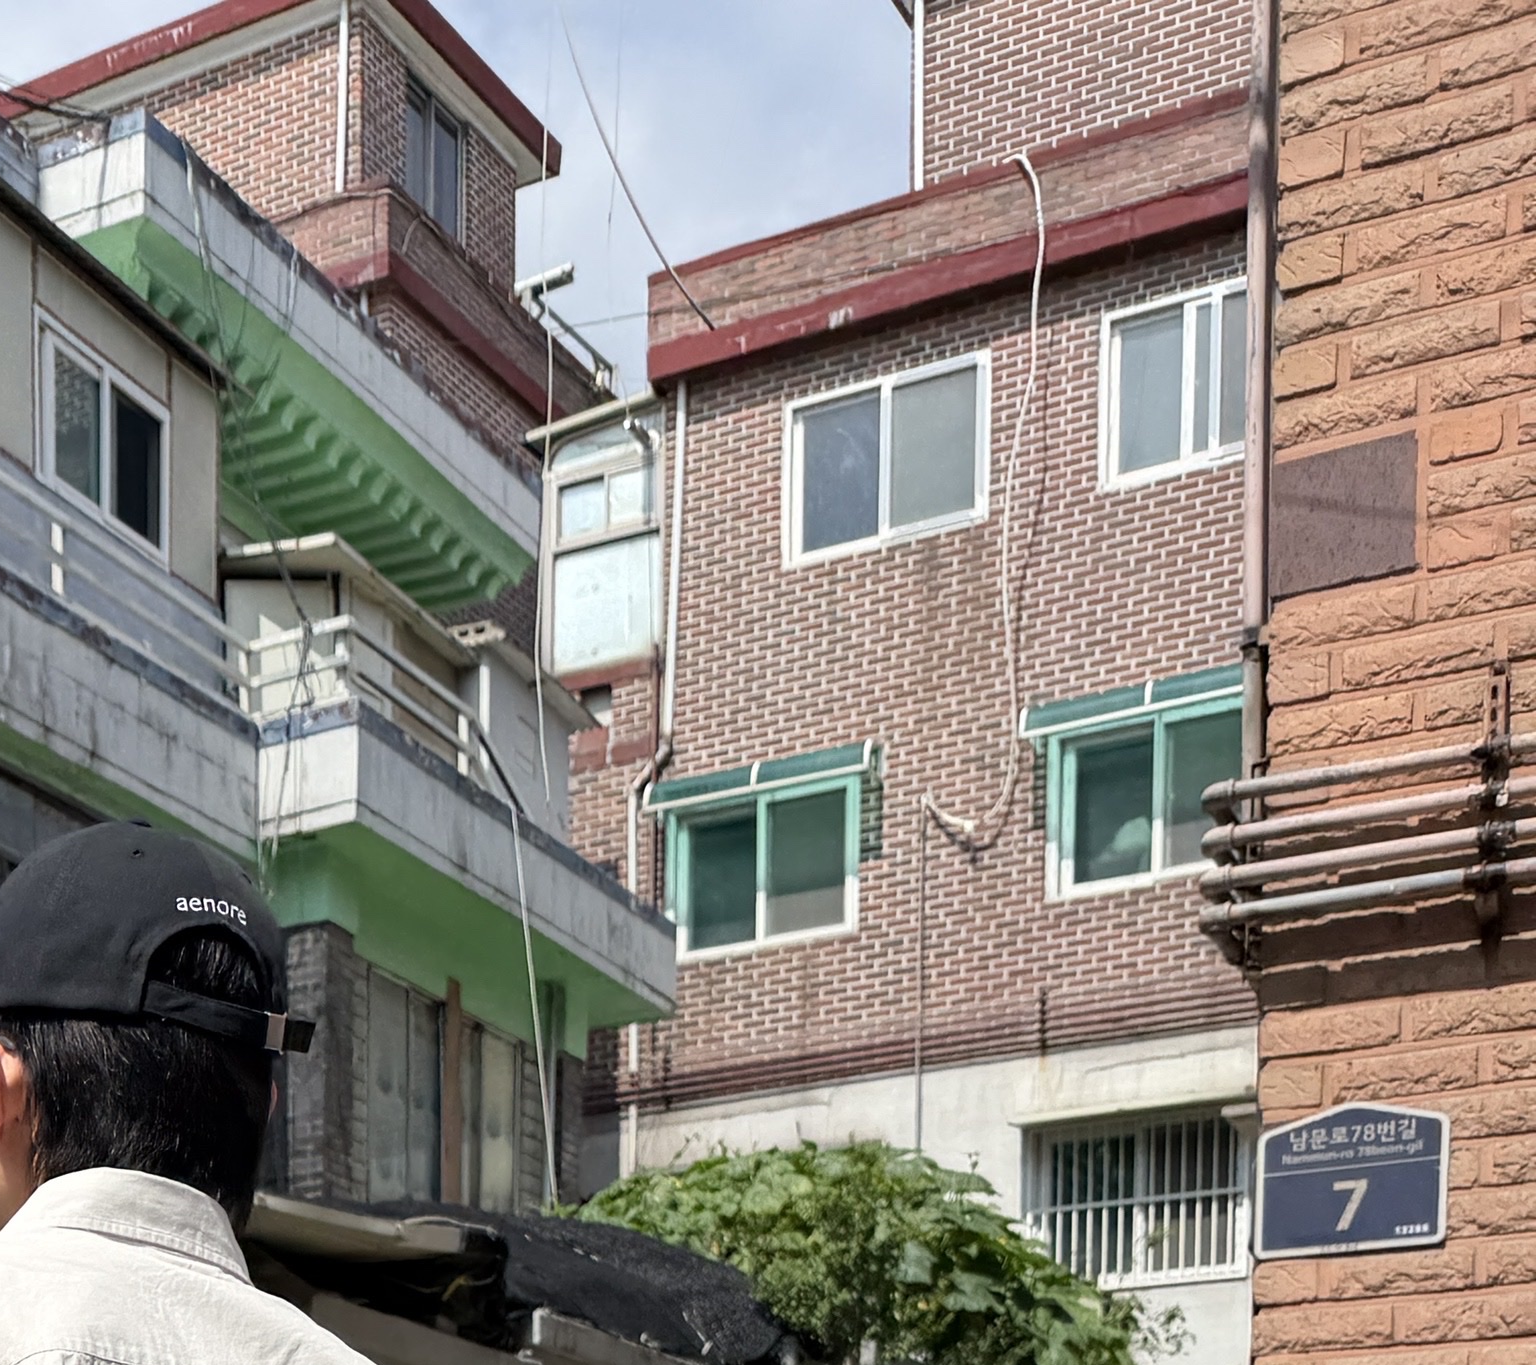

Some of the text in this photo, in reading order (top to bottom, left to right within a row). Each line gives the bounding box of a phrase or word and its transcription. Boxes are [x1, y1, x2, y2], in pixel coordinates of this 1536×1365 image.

[176, 897, 247, 926] aenore
[1289, 1116, 1417, 1153] 남문로78번길
[1332, 1177, 1369, 1232] 7
